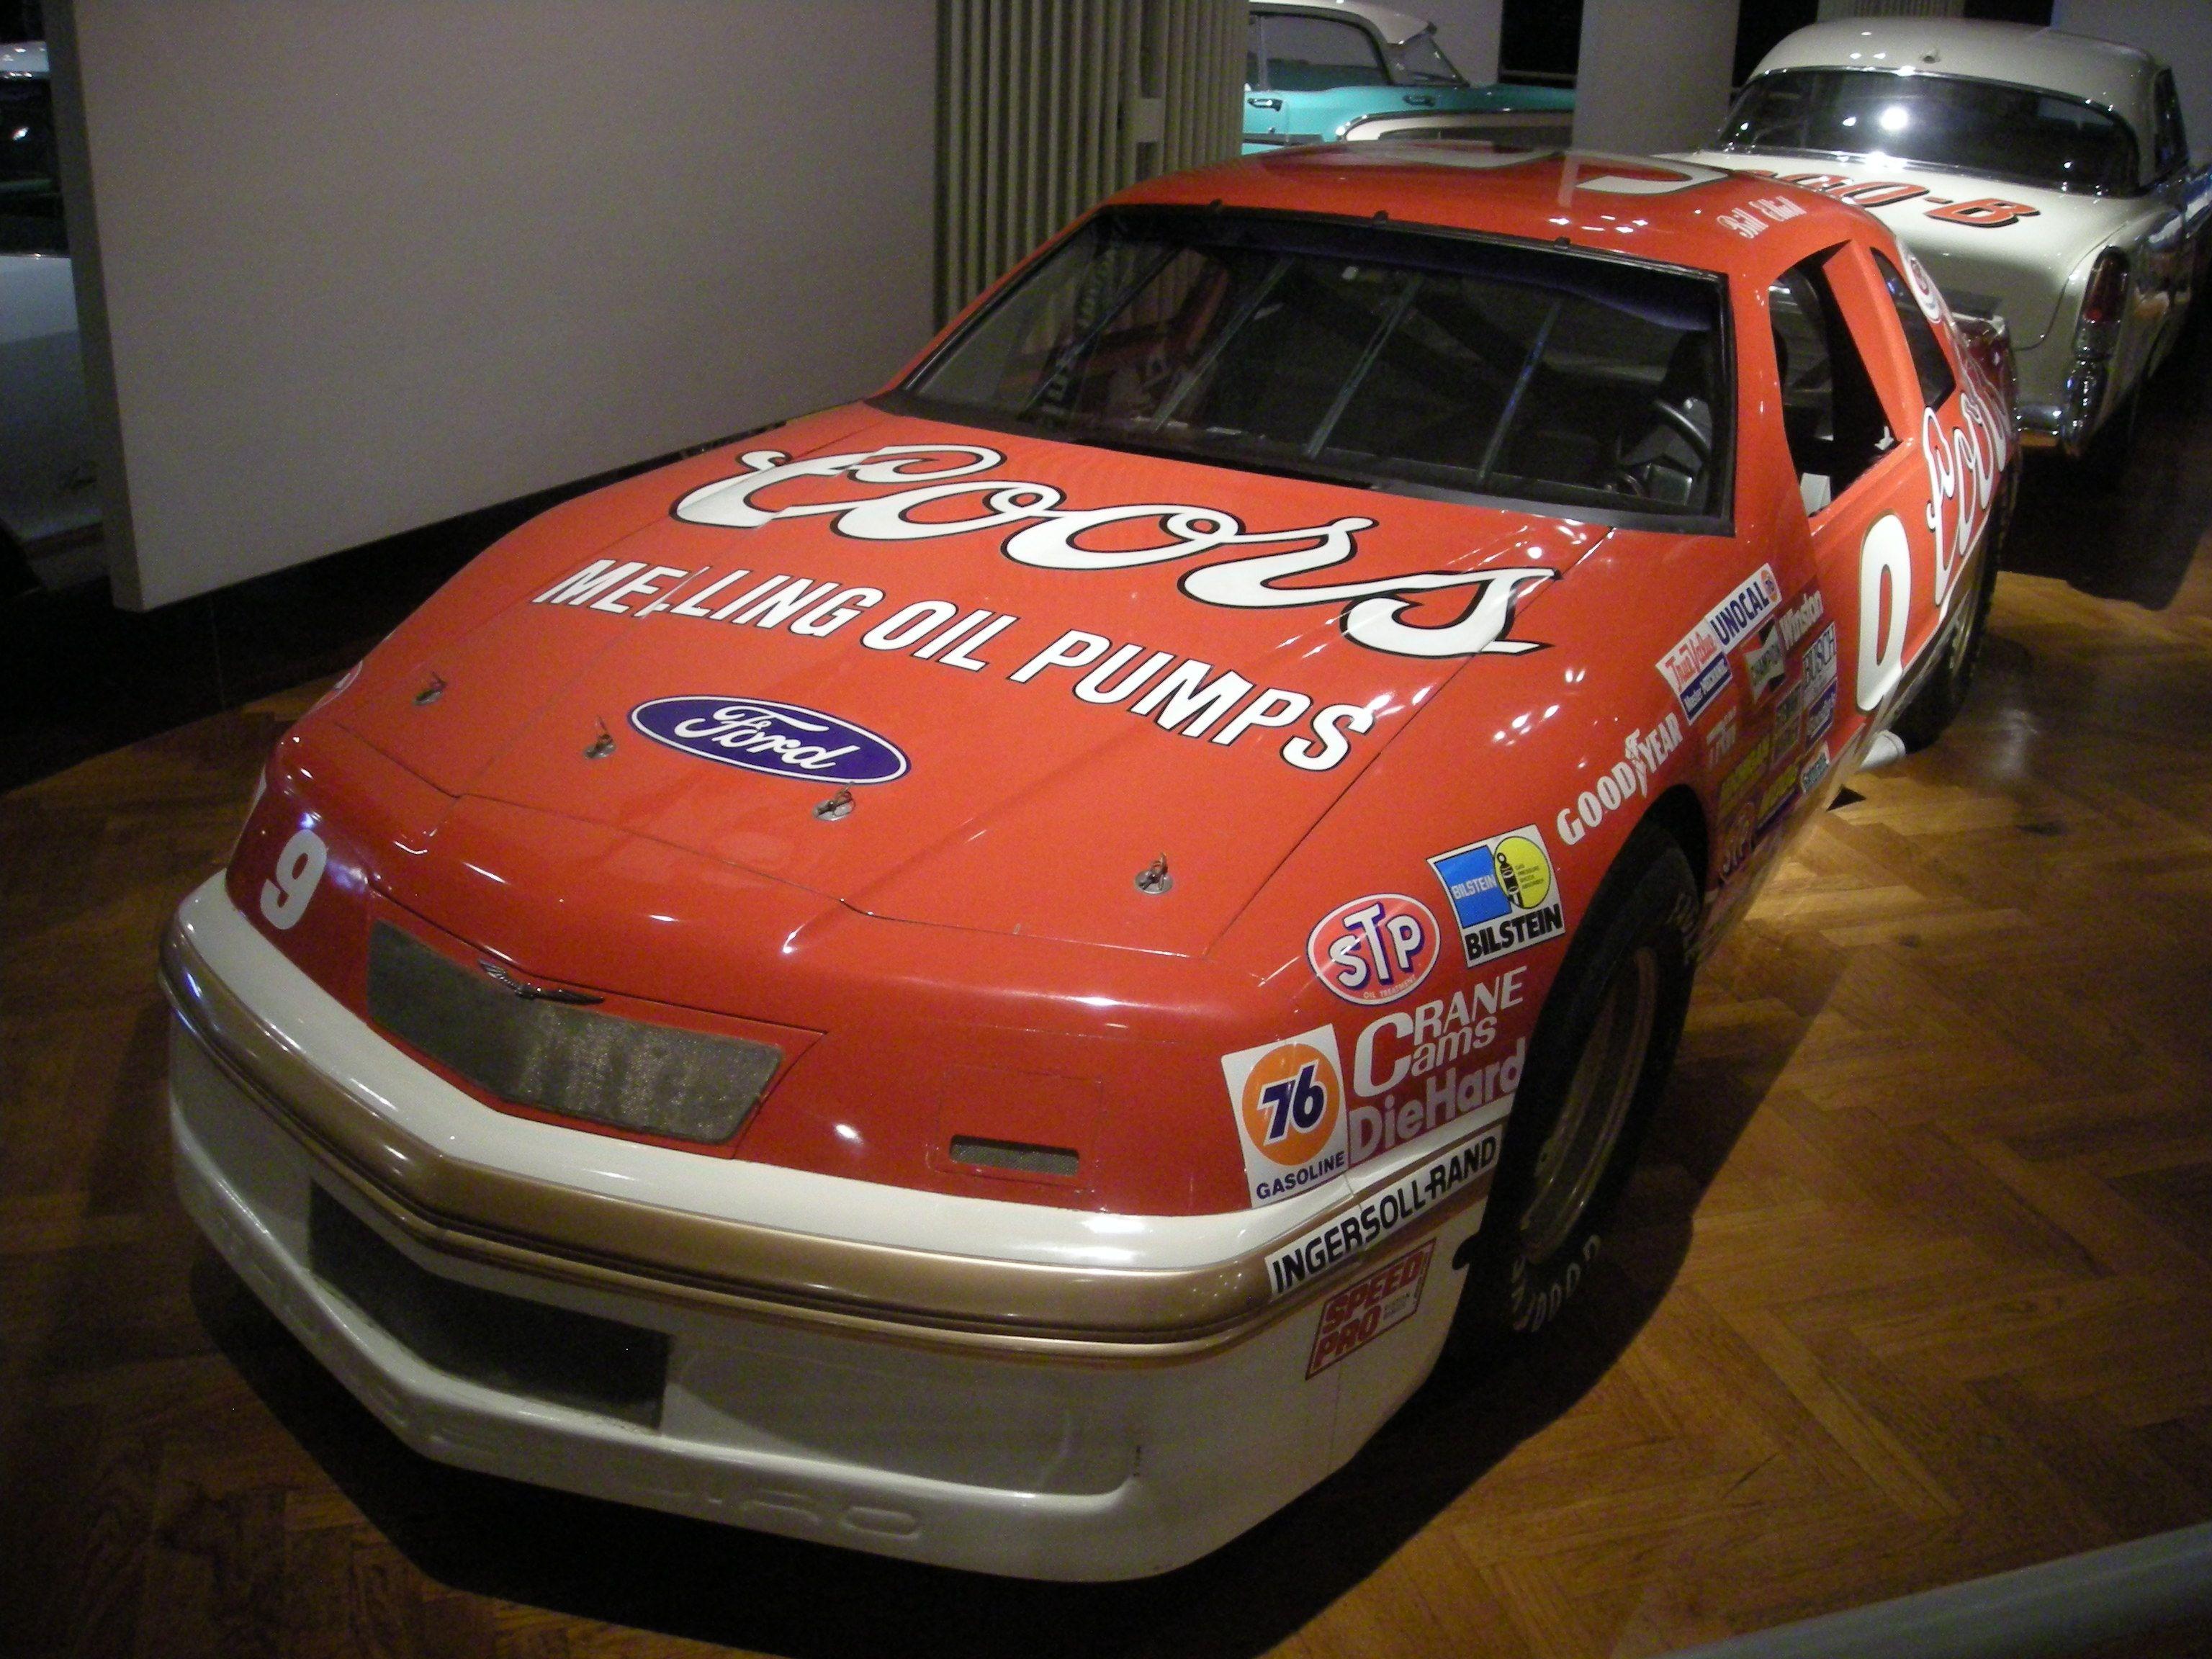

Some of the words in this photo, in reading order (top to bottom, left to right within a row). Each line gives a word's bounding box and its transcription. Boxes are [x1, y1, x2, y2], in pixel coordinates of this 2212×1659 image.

[670, 444, 1563, 658] Coors
[1709, 580, 1770, 645] UNOCAL
[1779, 590, 1824, 651] Winston
[531, 559, 886, 638] MELLING
[861, 599, 1020, 673] OIL
[1008, 629, 1377, 772] PUMPS
[673, 705, 861, 770] Ford
[1556, 711, 1683, 846] GOODYEAR
[260, 828, 328, 931] 9
[1450, 873, 1498, 900] BILSTEIN
[1328, 902, 1424, 988] STP
[1465, 903, 1563, 961] BILSTEIN
[1354, 966, 1527, 1097] CRANE
[1256, 1058, 1328, 1147] 76
[1349, 1035, 1526, 1164] DieHard
[1256, 1150, 1345, 1201] GASOLINE
[1272, 1136, 1498, 1294] INGERSOLL-RAND
[1324, 1250, 1426, 1334] SPEED
[1315, 1305, 1382, 1369] PRO
